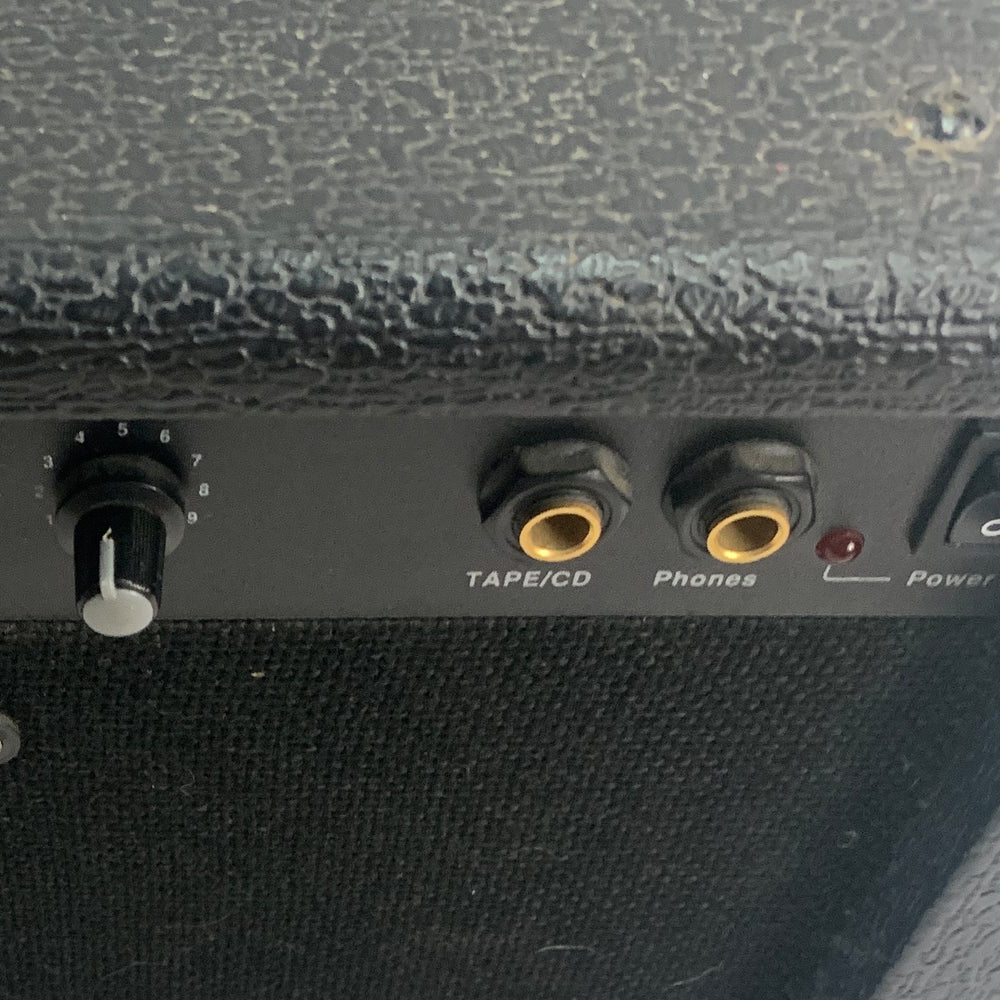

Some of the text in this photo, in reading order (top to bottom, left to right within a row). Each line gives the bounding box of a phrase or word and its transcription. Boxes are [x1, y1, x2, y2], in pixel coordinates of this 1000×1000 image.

[118, 422, 129, 437] 5
[159, 429, 171, 443] 6
[75, 430, 85, 444] 4
[43, 455, 54, 469] 3
[191, 453, 202, 467] 7
[199, 482, 210, 497] 8
[187, 511, 198, 525] 9
[466, 570, 592, 588] TAPE/CD
[653, 570, 758, 588] Phones
[906, 570, 995, 588] Power
